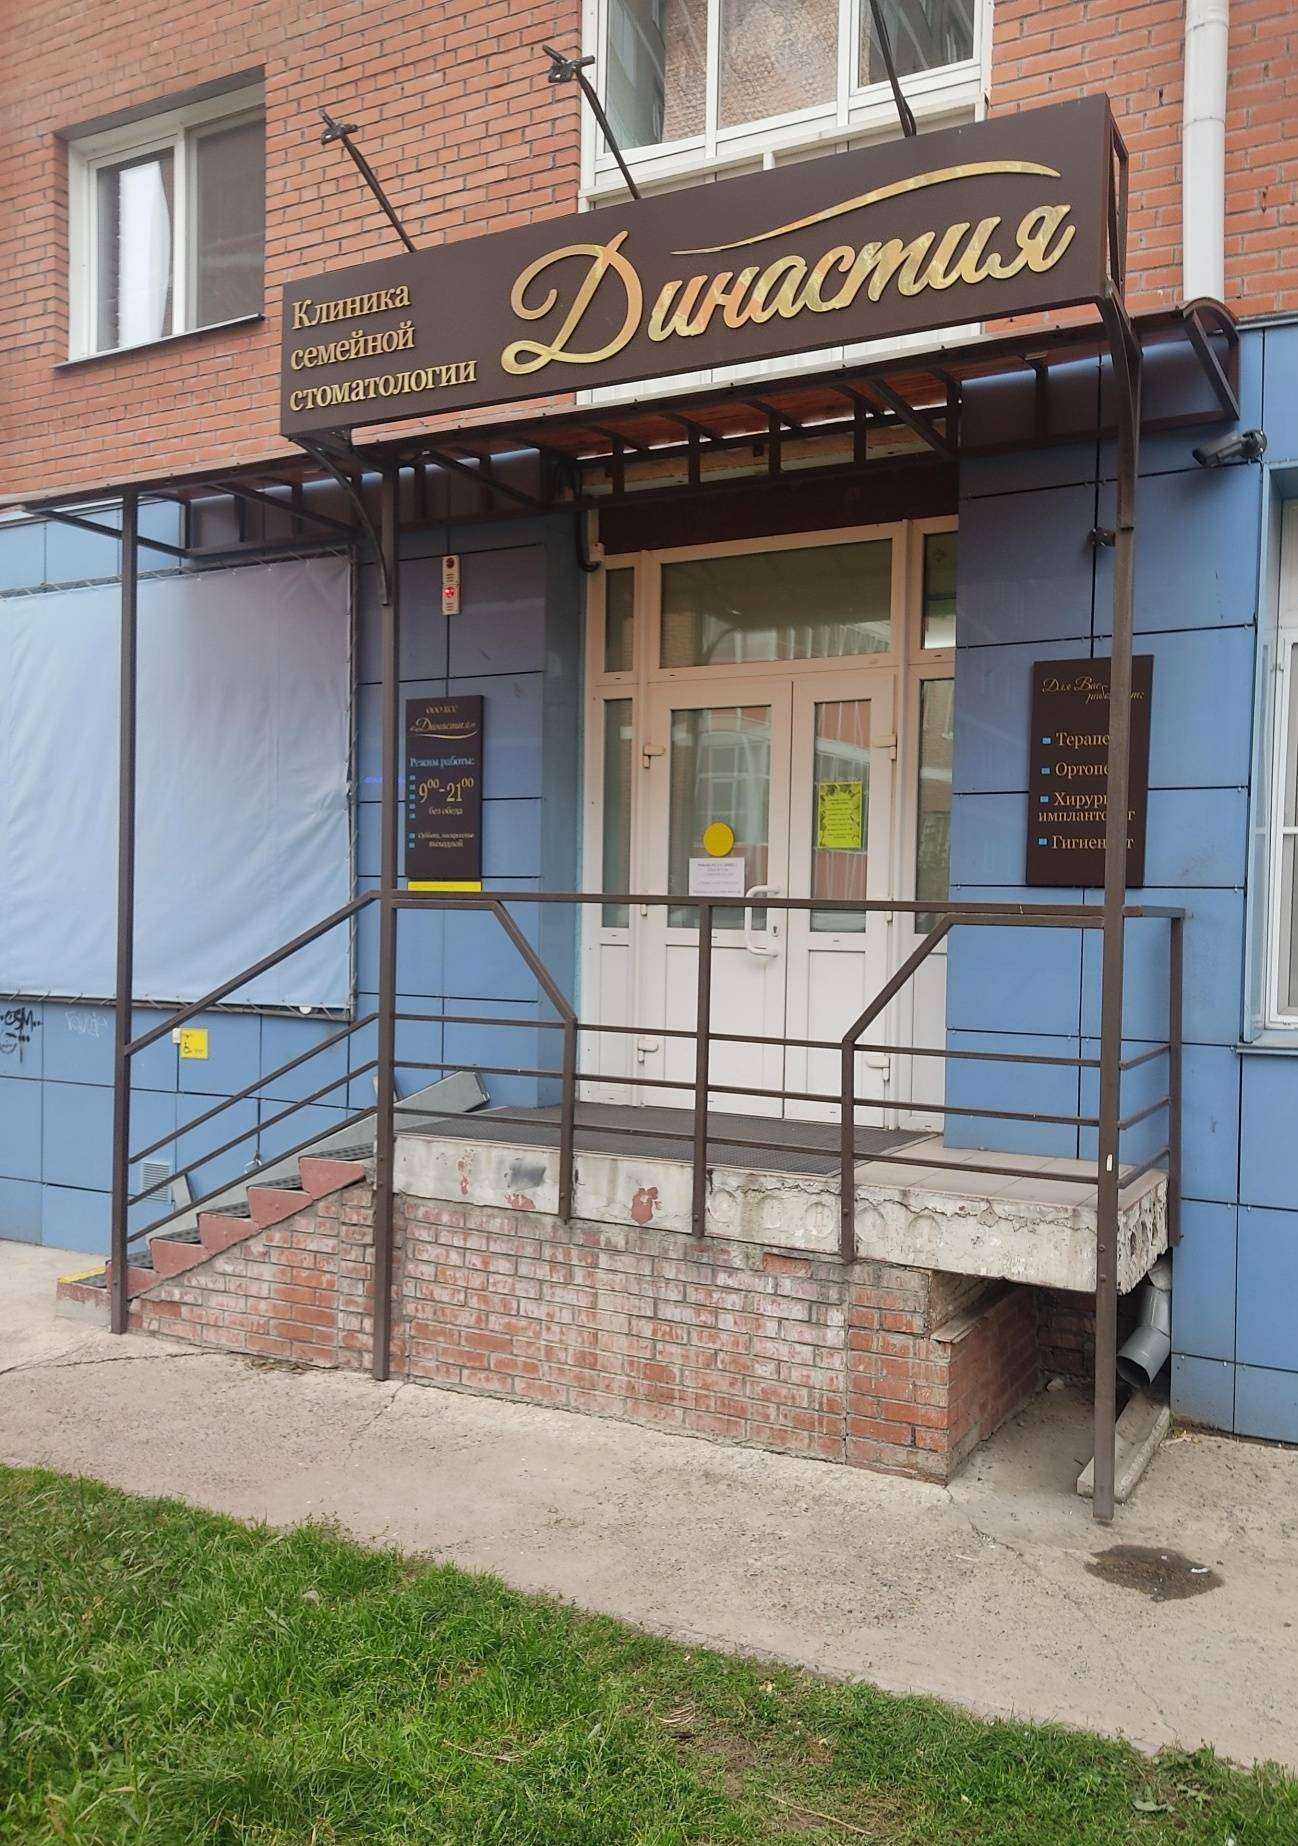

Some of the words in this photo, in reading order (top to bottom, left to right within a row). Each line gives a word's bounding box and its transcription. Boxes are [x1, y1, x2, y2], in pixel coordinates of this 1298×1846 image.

[291, 284, 411, 329] Клиника
[501, 204, 1076, 375] Династия
[290, 320, 415, 371] семейной
[289, 360, 478, 412] стоматологии
[1051, 835, 1135, 849] Гигиент
